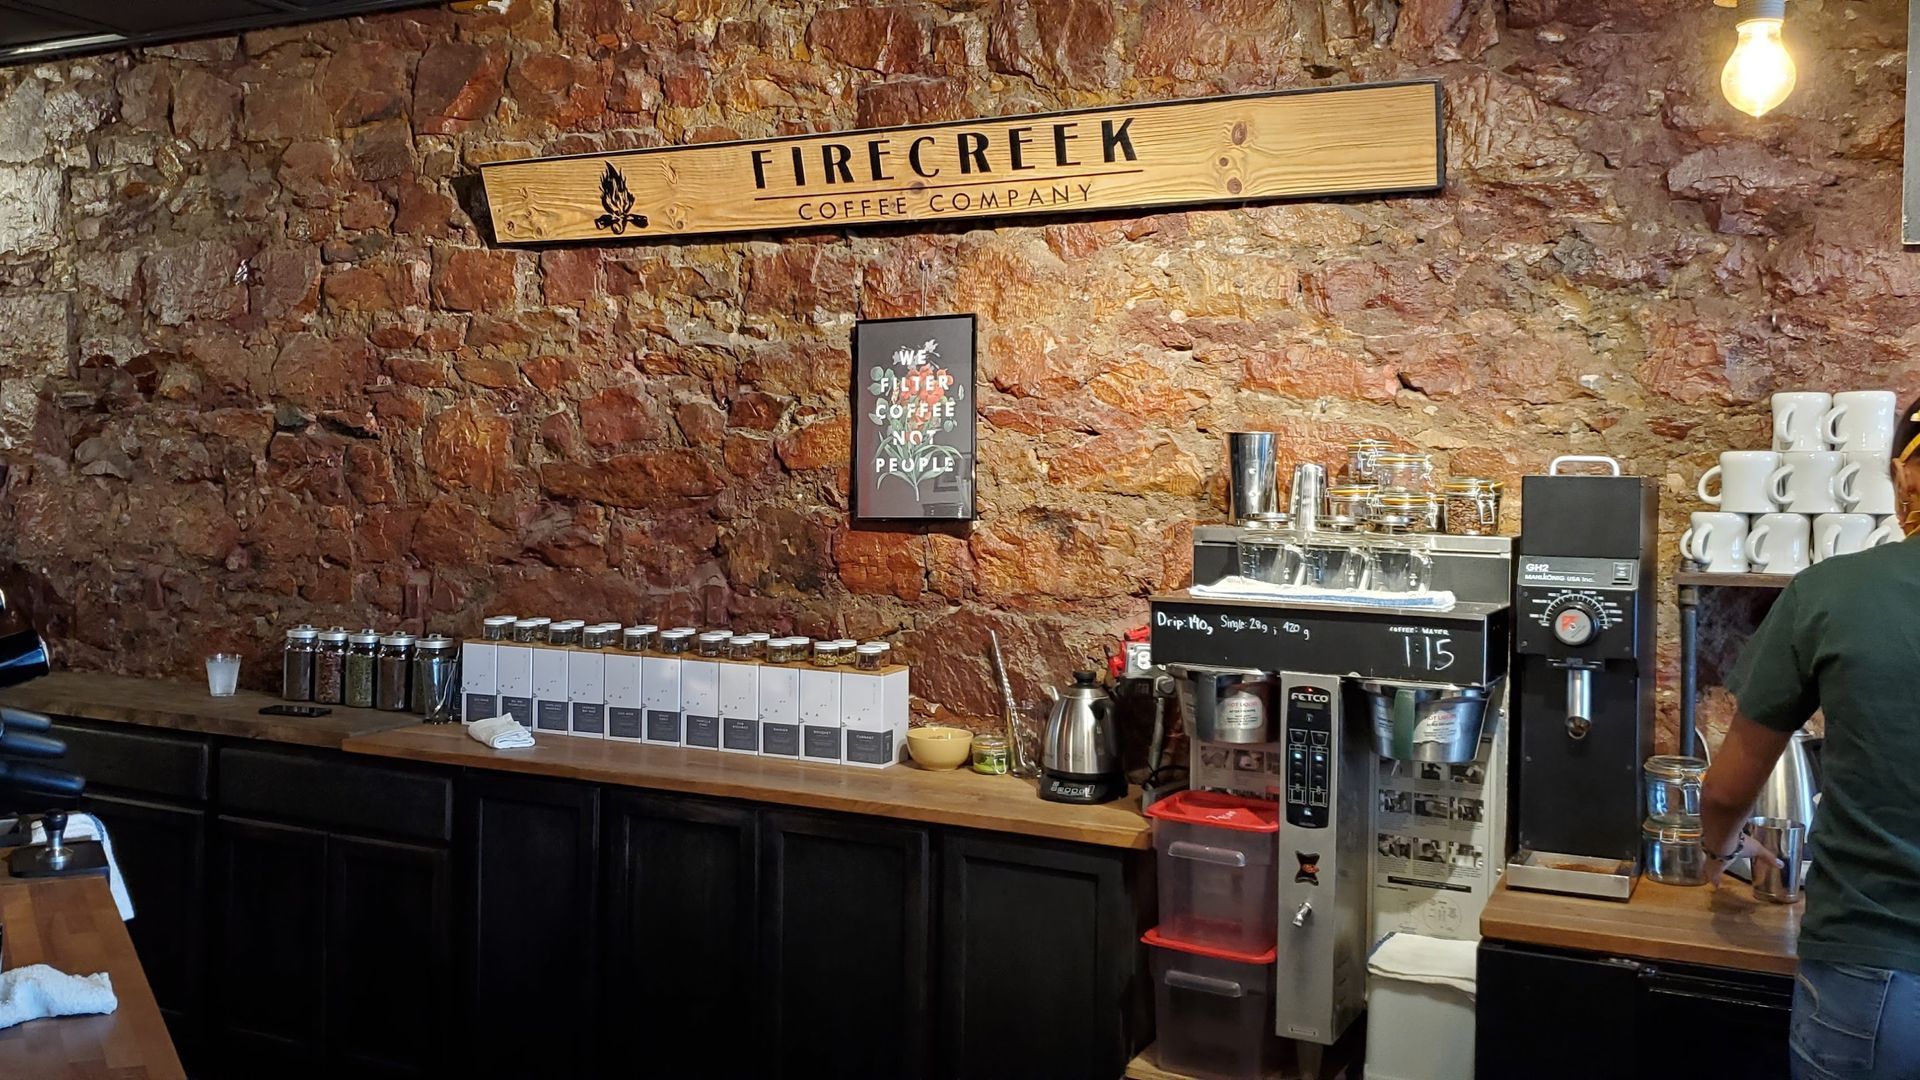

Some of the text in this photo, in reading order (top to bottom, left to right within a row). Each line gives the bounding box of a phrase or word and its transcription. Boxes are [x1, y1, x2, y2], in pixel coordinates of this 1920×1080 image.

[751, 118, 1137, 189] FIRECREEK
[798, 184, 1091, 220] COFFEE COMPANY
[899, 350, 927, 366] WE
[880, 375, 949, 392] FILTER
[875, 403, 954, 419] COFFEE
[892, 430, 937, 446] NOT
[875, 457, 954, 473] PEOPLE
[1525, 563, 1549, 572] GH2
[1421, 627, 1450, 636] WATER
[1405, 636, 1455, 671] 1:15
[1291, 692, 1329, 703] FETCO
